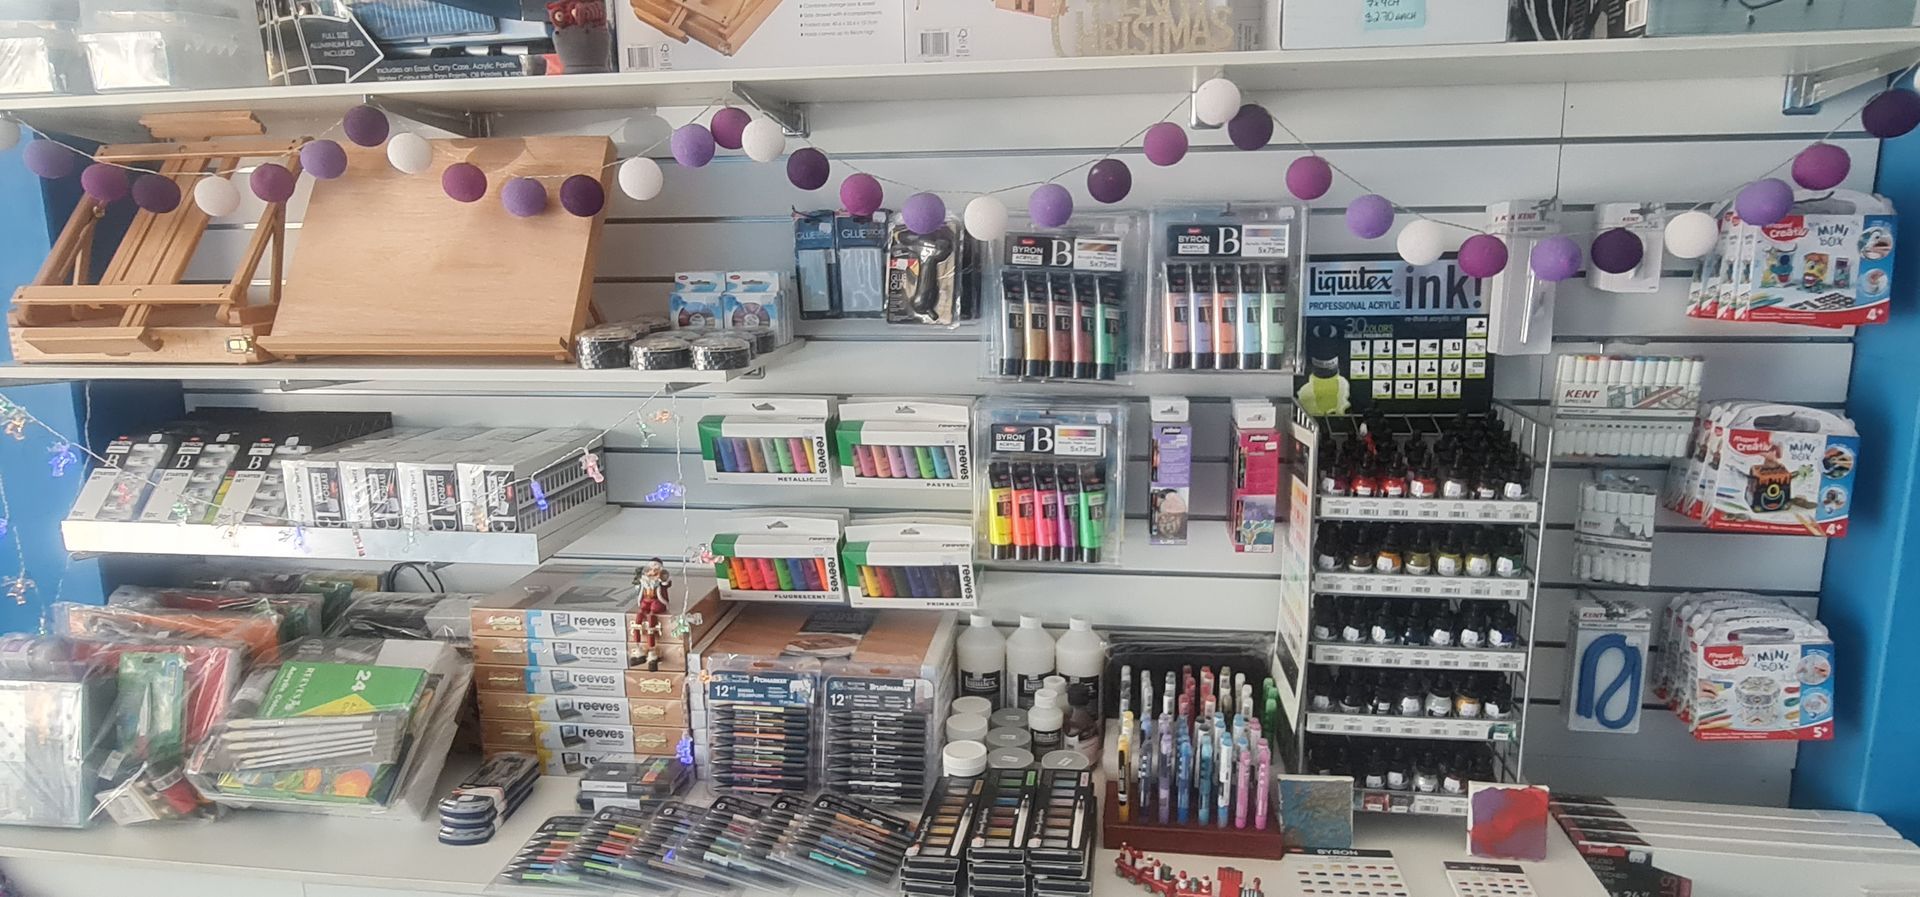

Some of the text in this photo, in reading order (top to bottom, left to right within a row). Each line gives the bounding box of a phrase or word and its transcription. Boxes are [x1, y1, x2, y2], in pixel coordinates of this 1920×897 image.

[310, 40, 365, 49] ALUMINIUM EASEL
[841, 228, 867, 239] GLUE
[1817, 223, 1849, 236] MINI
[1177, 235, 1210, 243] BYRON
[1216, 226, 1240, 255] B
[1819, 235, 1845, 246] BOX
[1012, 245, 1044, 254] BYRON
[1049, 239, 1073, 267] B
[1309, 264, 1482, 310] Liquitex ink!
[1308, 300, 1400, 310] PROFESSIONAL ACRYLIC
[1344, 317, 1394, 333] 30 COLORS
[1565, 389, 1600, 399] KENT
[996, 433, 1026, 441] BYRON
[1031, 426, 1054, 452] B
[1789, 443, 1816, 453] MINI
[816, 436, 828, 474] reeves
[176, 455, 192, 469] B
[248, 456, 263, 470] B
[958, 444, 969, 480] reeves
[430, 513, 457, 531] B
[488, 515, 517, 532] B
[1825, 523, 1842, 536] 4+
[827, 557, 839, 592] reeves
[962, 564, 973, 599] reeves
[574, 616, 616, 627] reeves
[575, 646, 618, 656] reeves
[1757, 650, 1789, 662] MINI
[1761, 661, 1785, 672] BOX
[351, 670, 372, 691] 24
[573, 674, 616, 684] reeves
[578, 702, 620, 712] reeves
[582, 728, 625, 739] reeves
[1813, 726, 1828, 738] 5+
[716, 802, 726, 810] 6
[777, 801, 787, 809] 6
[663, 807, 674, 816] 6
[1316, 848, 1359, 856] BYRON
